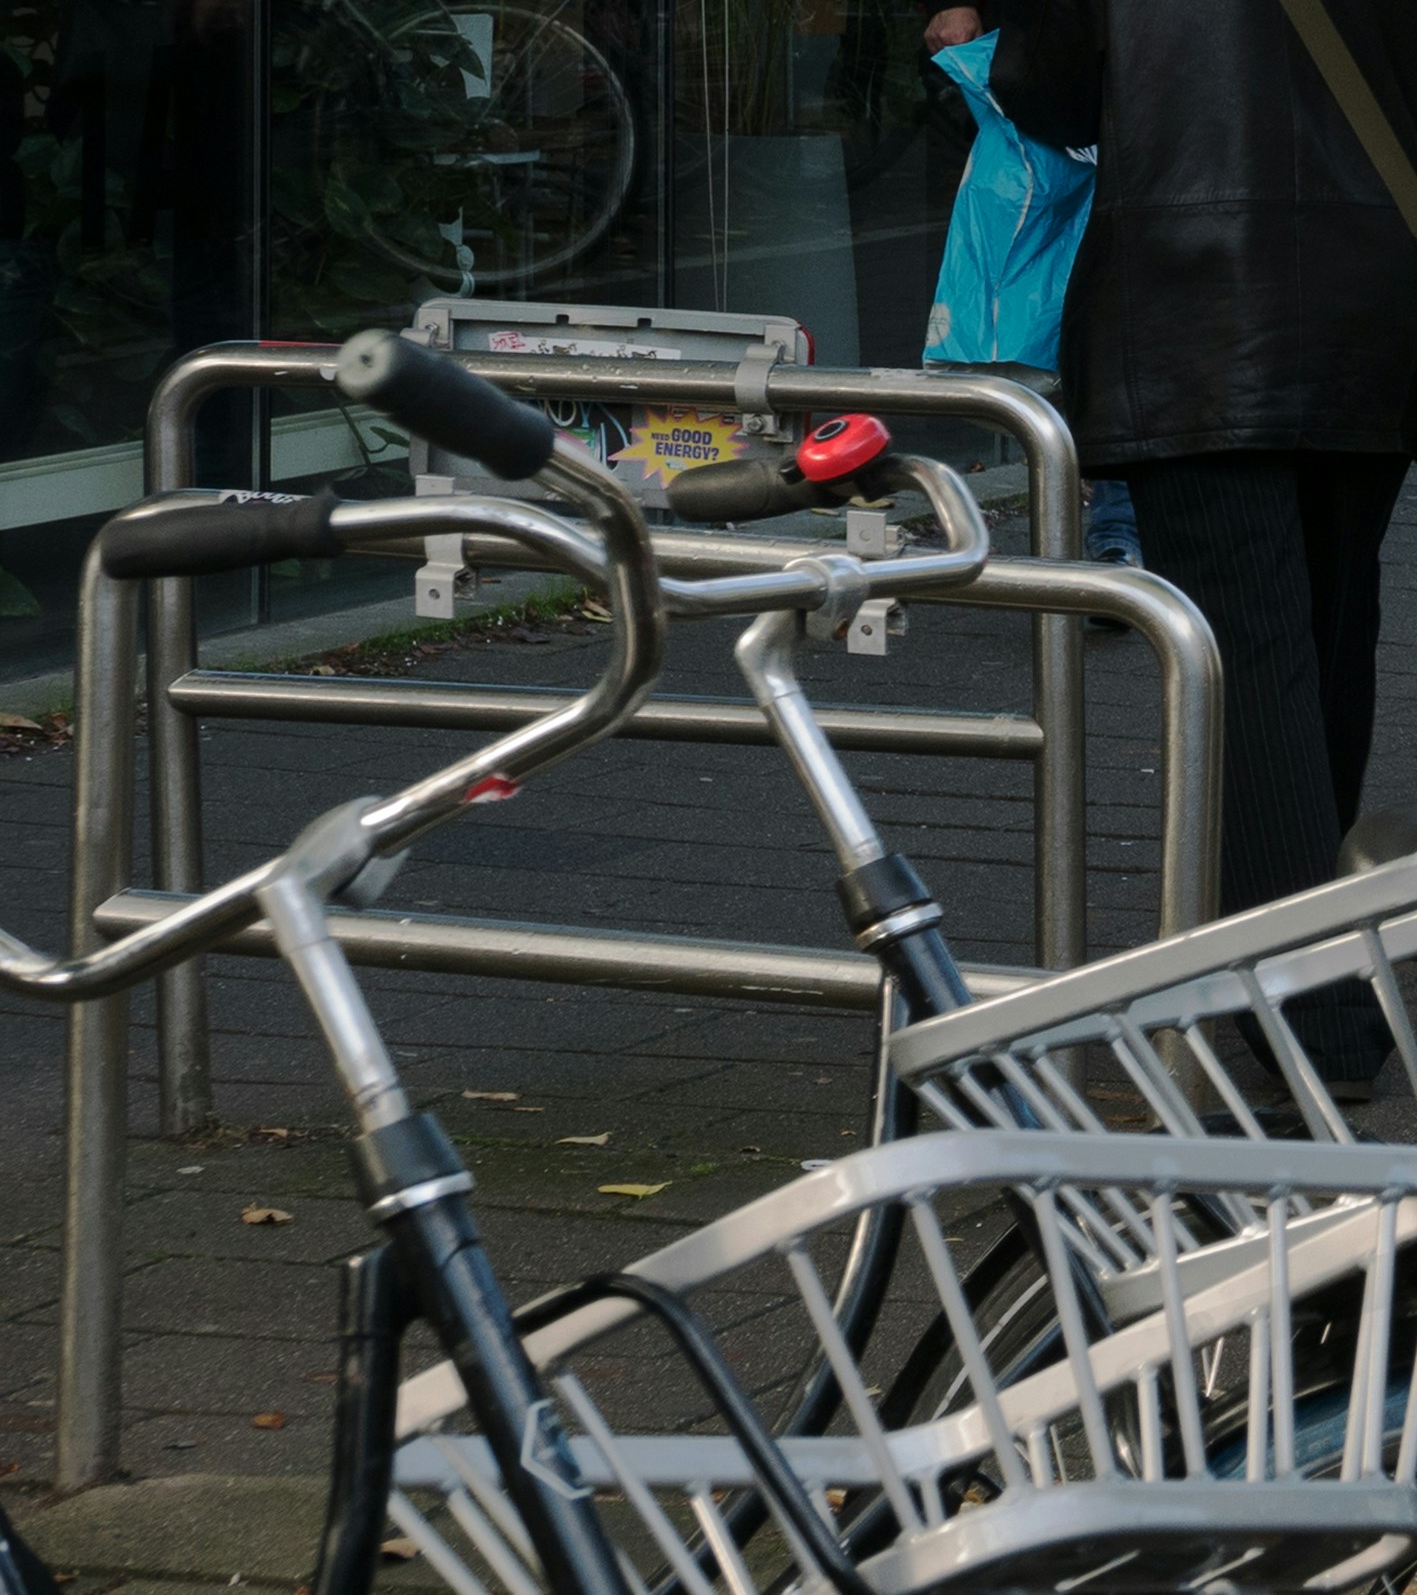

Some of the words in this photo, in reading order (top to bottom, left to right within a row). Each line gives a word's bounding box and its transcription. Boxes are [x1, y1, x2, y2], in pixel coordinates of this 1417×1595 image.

[650, 432, 670, 441] NEED
[671, 428, 713, 445] GOOD
[655, 442, 720, 461] ENERGY?
